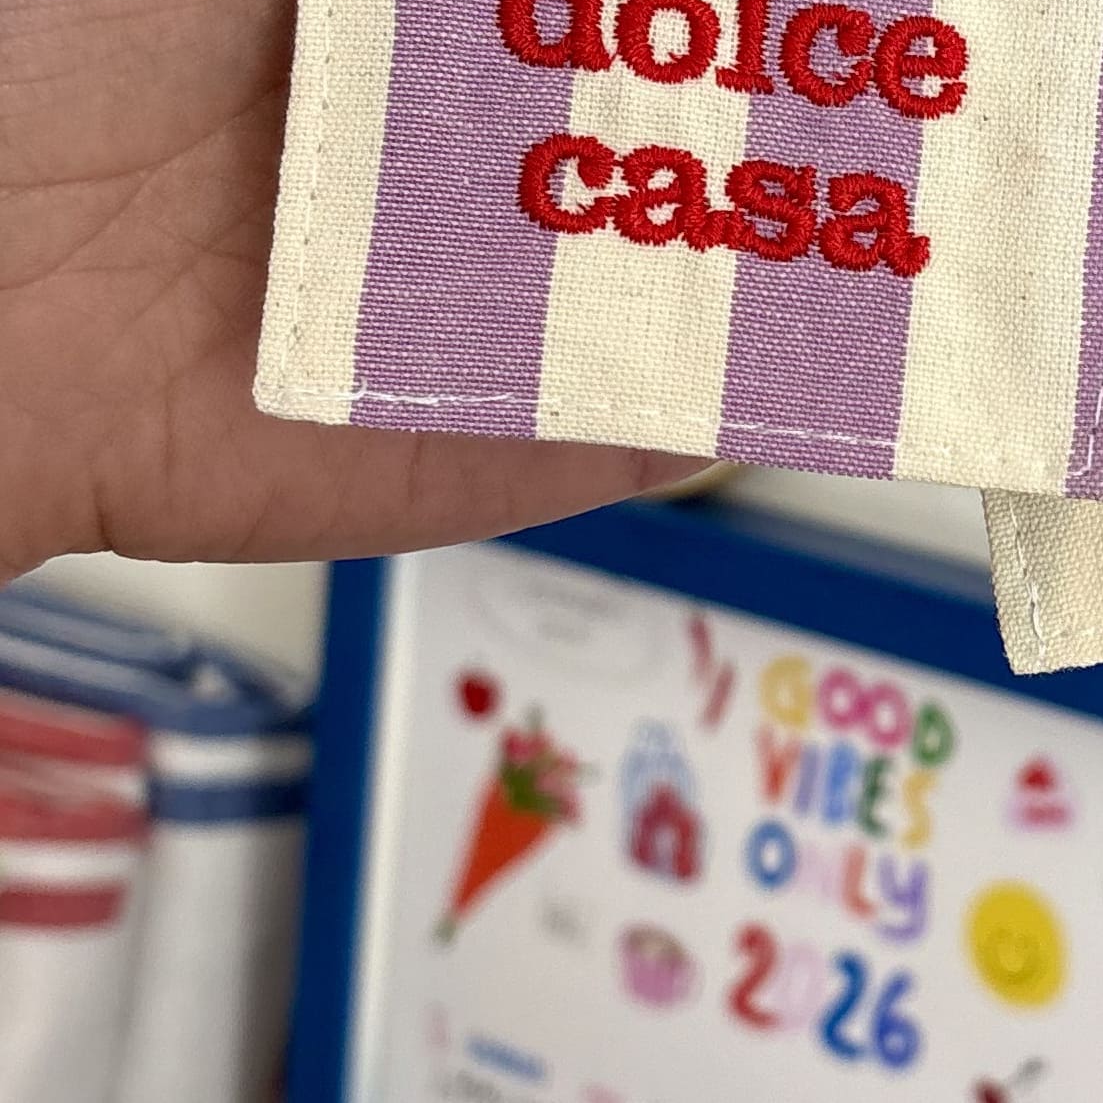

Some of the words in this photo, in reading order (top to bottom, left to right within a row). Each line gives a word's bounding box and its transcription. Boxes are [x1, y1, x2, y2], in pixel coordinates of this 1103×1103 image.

[518, 132, 931, 278] casa
[757, 654, 957, 768] GOOD
[725, 919, 924, 1070] 2026
